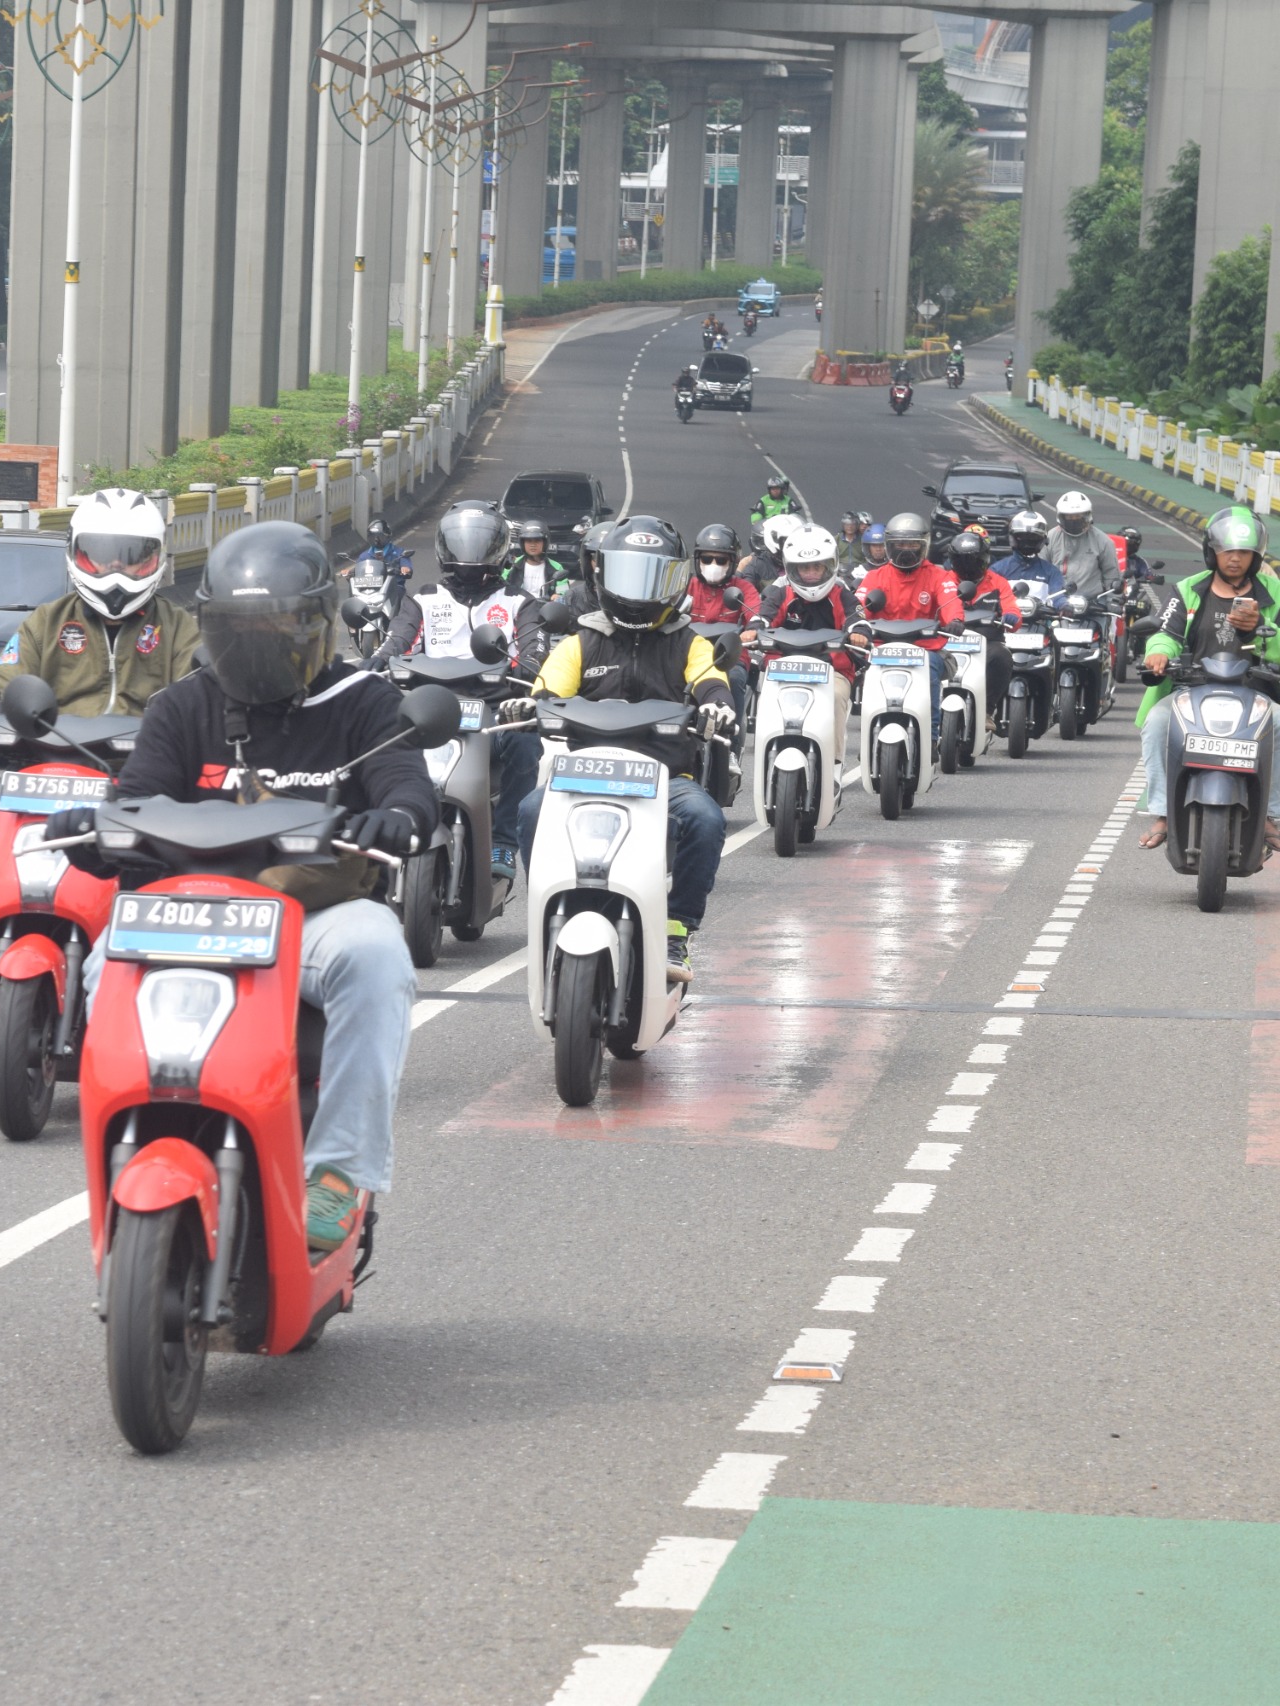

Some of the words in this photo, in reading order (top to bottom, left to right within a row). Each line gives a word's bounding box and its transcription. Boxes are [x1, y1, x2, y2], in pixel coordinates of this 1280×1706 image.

[232, 588, 270, 596] HONDA
[872, 648, 878, 656] B
[770, 661, 777, 670] B
[781, 662, 803, 672] 6921
[807, 663, 826, 673] JWA
[1189, 738, 1195, 749] B
[1200, 739, 1228, 753] 3050
[1234, 743, 1255, 756] PMF
[557, 757, 567, 771] B
[574, 758, 615, 775] 6925
[625, 761, 654, 778] VWA
[7, 775, 19, 791] B
[25, 776, 70, 795] 5756
[72, 779, 107, 797] BWE
[177, 880, 231, 889] HONDA
[121, 900, 139, 923] B
[146, 900, 213, 927] 4804
[196, 935, 269, 953] 03-29
